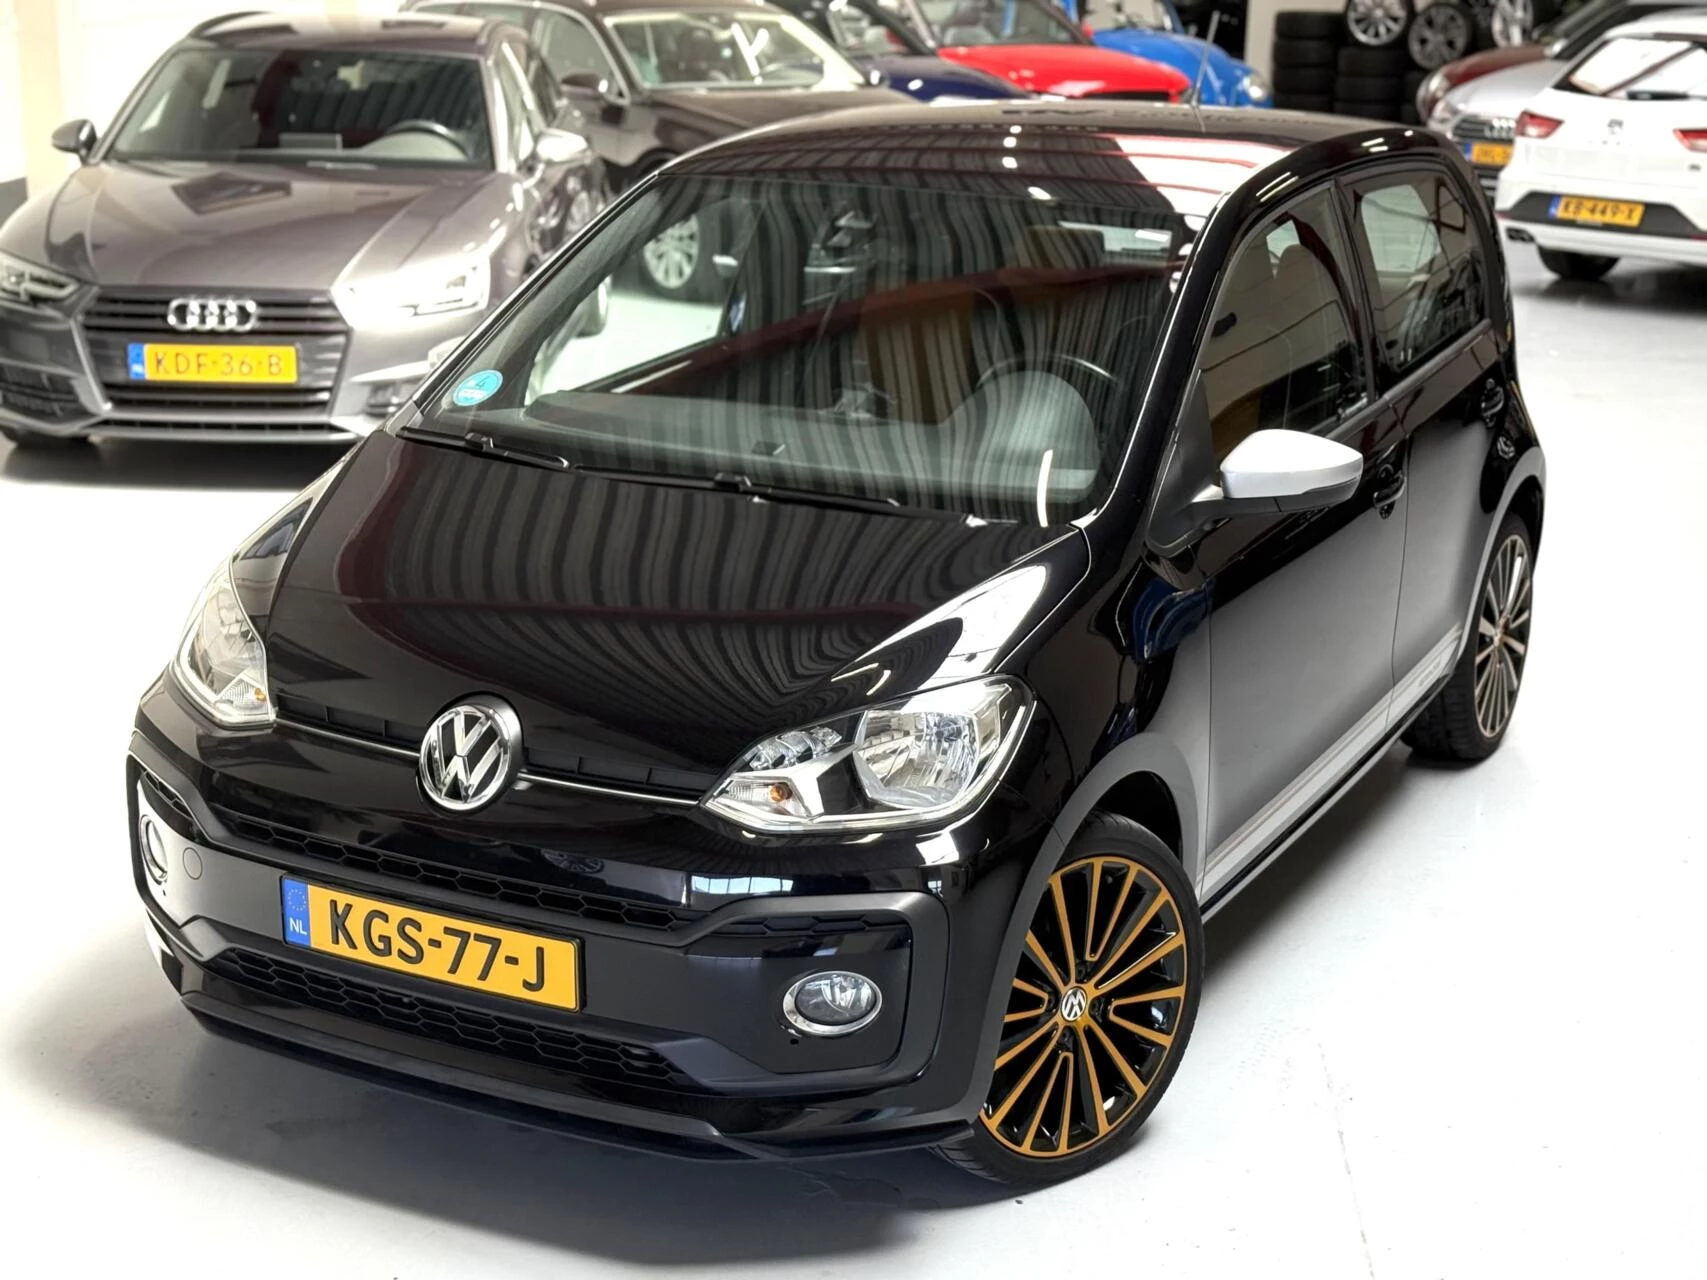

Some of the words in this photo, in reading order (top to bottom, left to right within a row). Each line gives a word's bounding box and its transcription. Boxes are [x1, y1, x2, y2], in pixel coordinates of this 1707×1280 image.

[155, 352, 282, 376] KDF-36-B
[289, 917, 307, 936] NL
[329, 899, 545, 992] KGS-77-J
